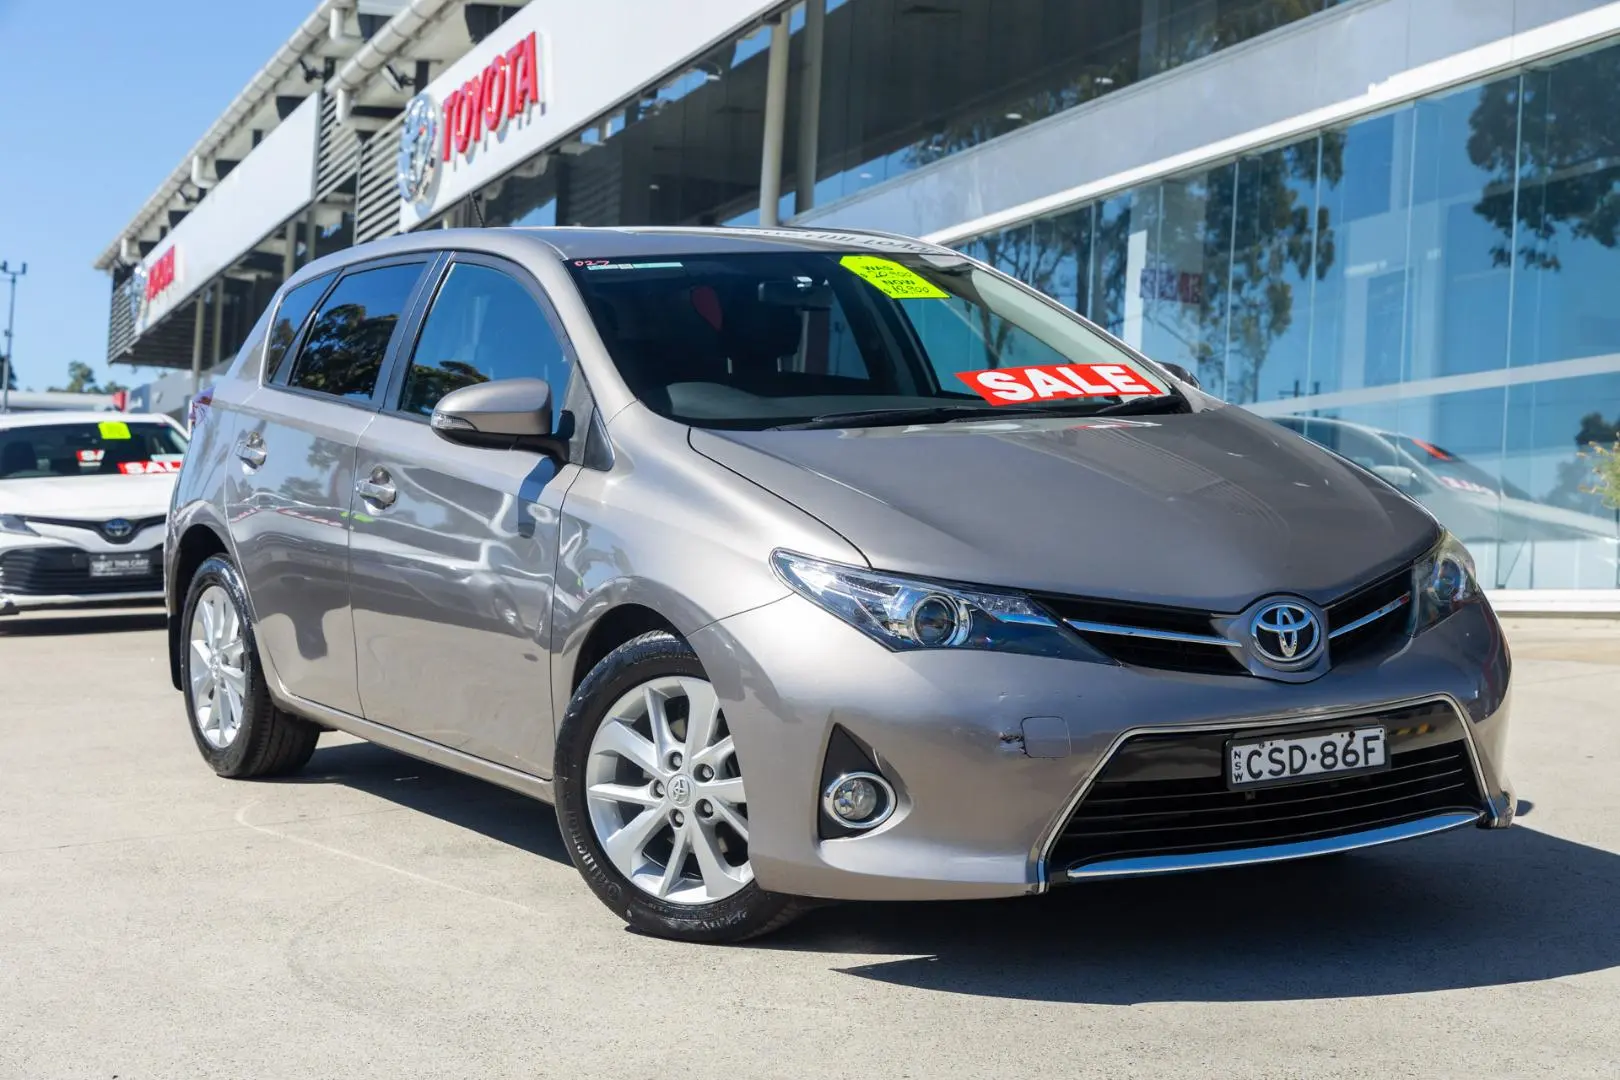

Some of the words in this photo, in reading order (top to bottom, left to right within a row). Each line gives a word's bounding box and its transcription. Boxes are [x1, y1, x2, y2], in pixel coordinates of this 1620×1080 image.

[441, 31, 538, 162] TOYOTA
[976, 365, 1151, 401] SALE
[125, 461, 181, 474] SAL
